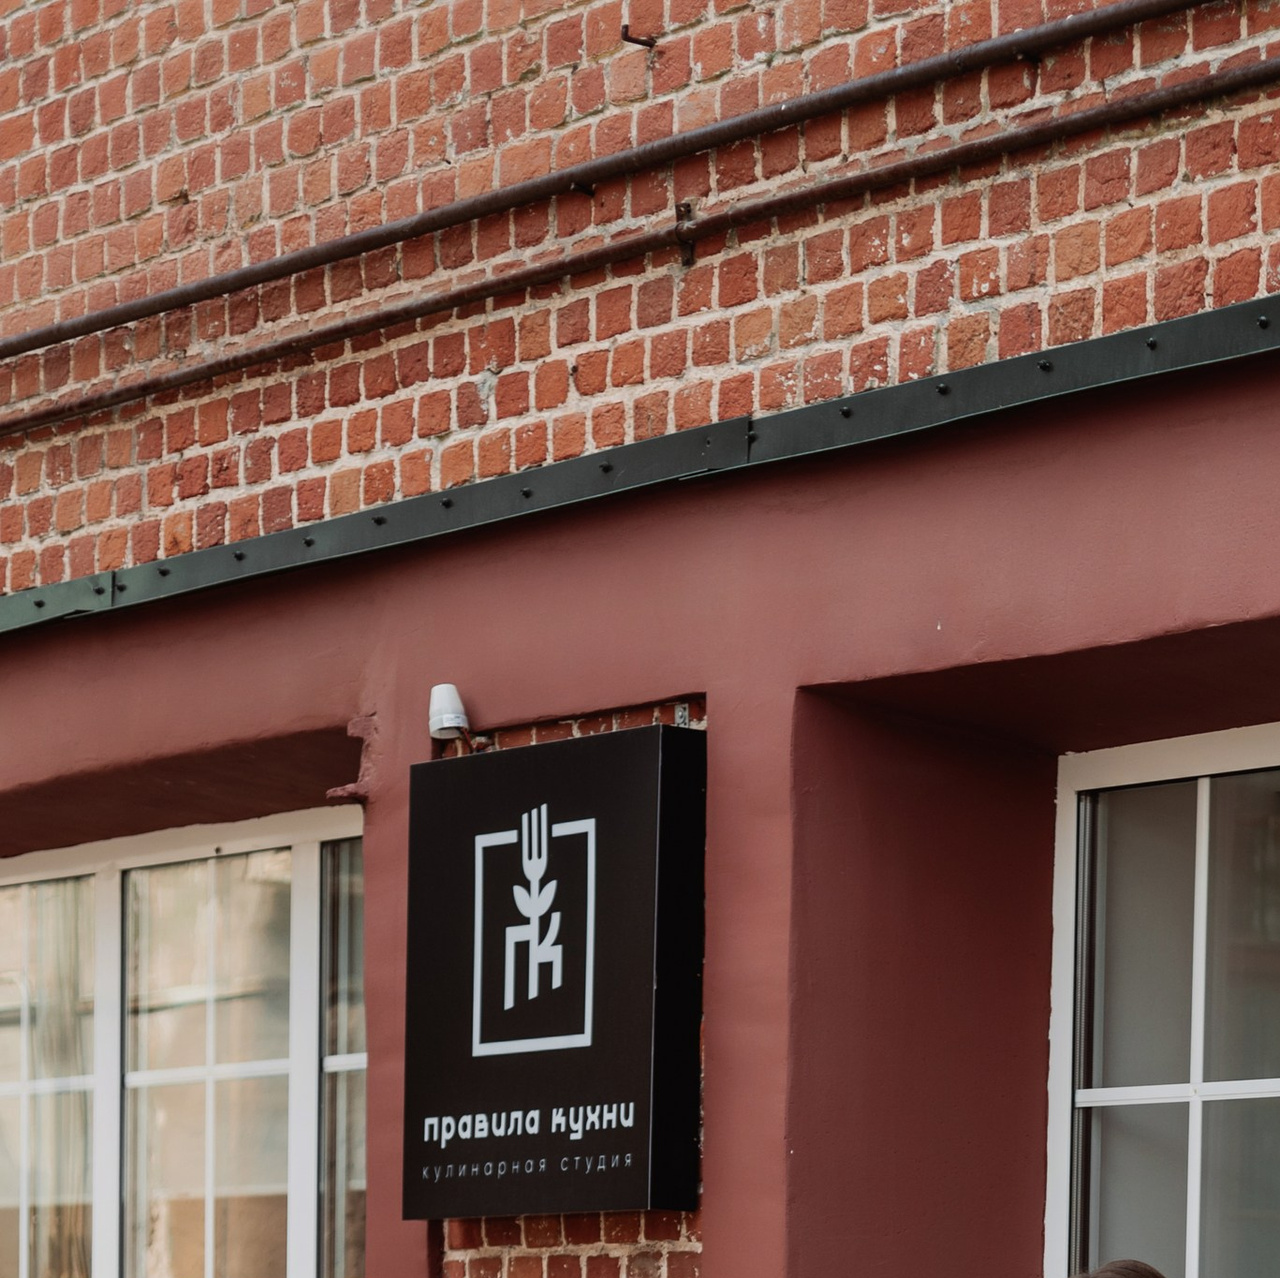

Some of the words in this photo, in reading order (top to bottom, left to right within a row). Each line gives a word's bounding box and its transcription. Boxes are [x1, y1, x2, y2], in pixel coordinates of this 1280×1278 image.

[423, 1109, 540, 1149] правила
[551, 1101, 635, 1140] кухни
[422, 1158, 546, 1183] кулинарная
[560, 1152, 632, 1174] студия
